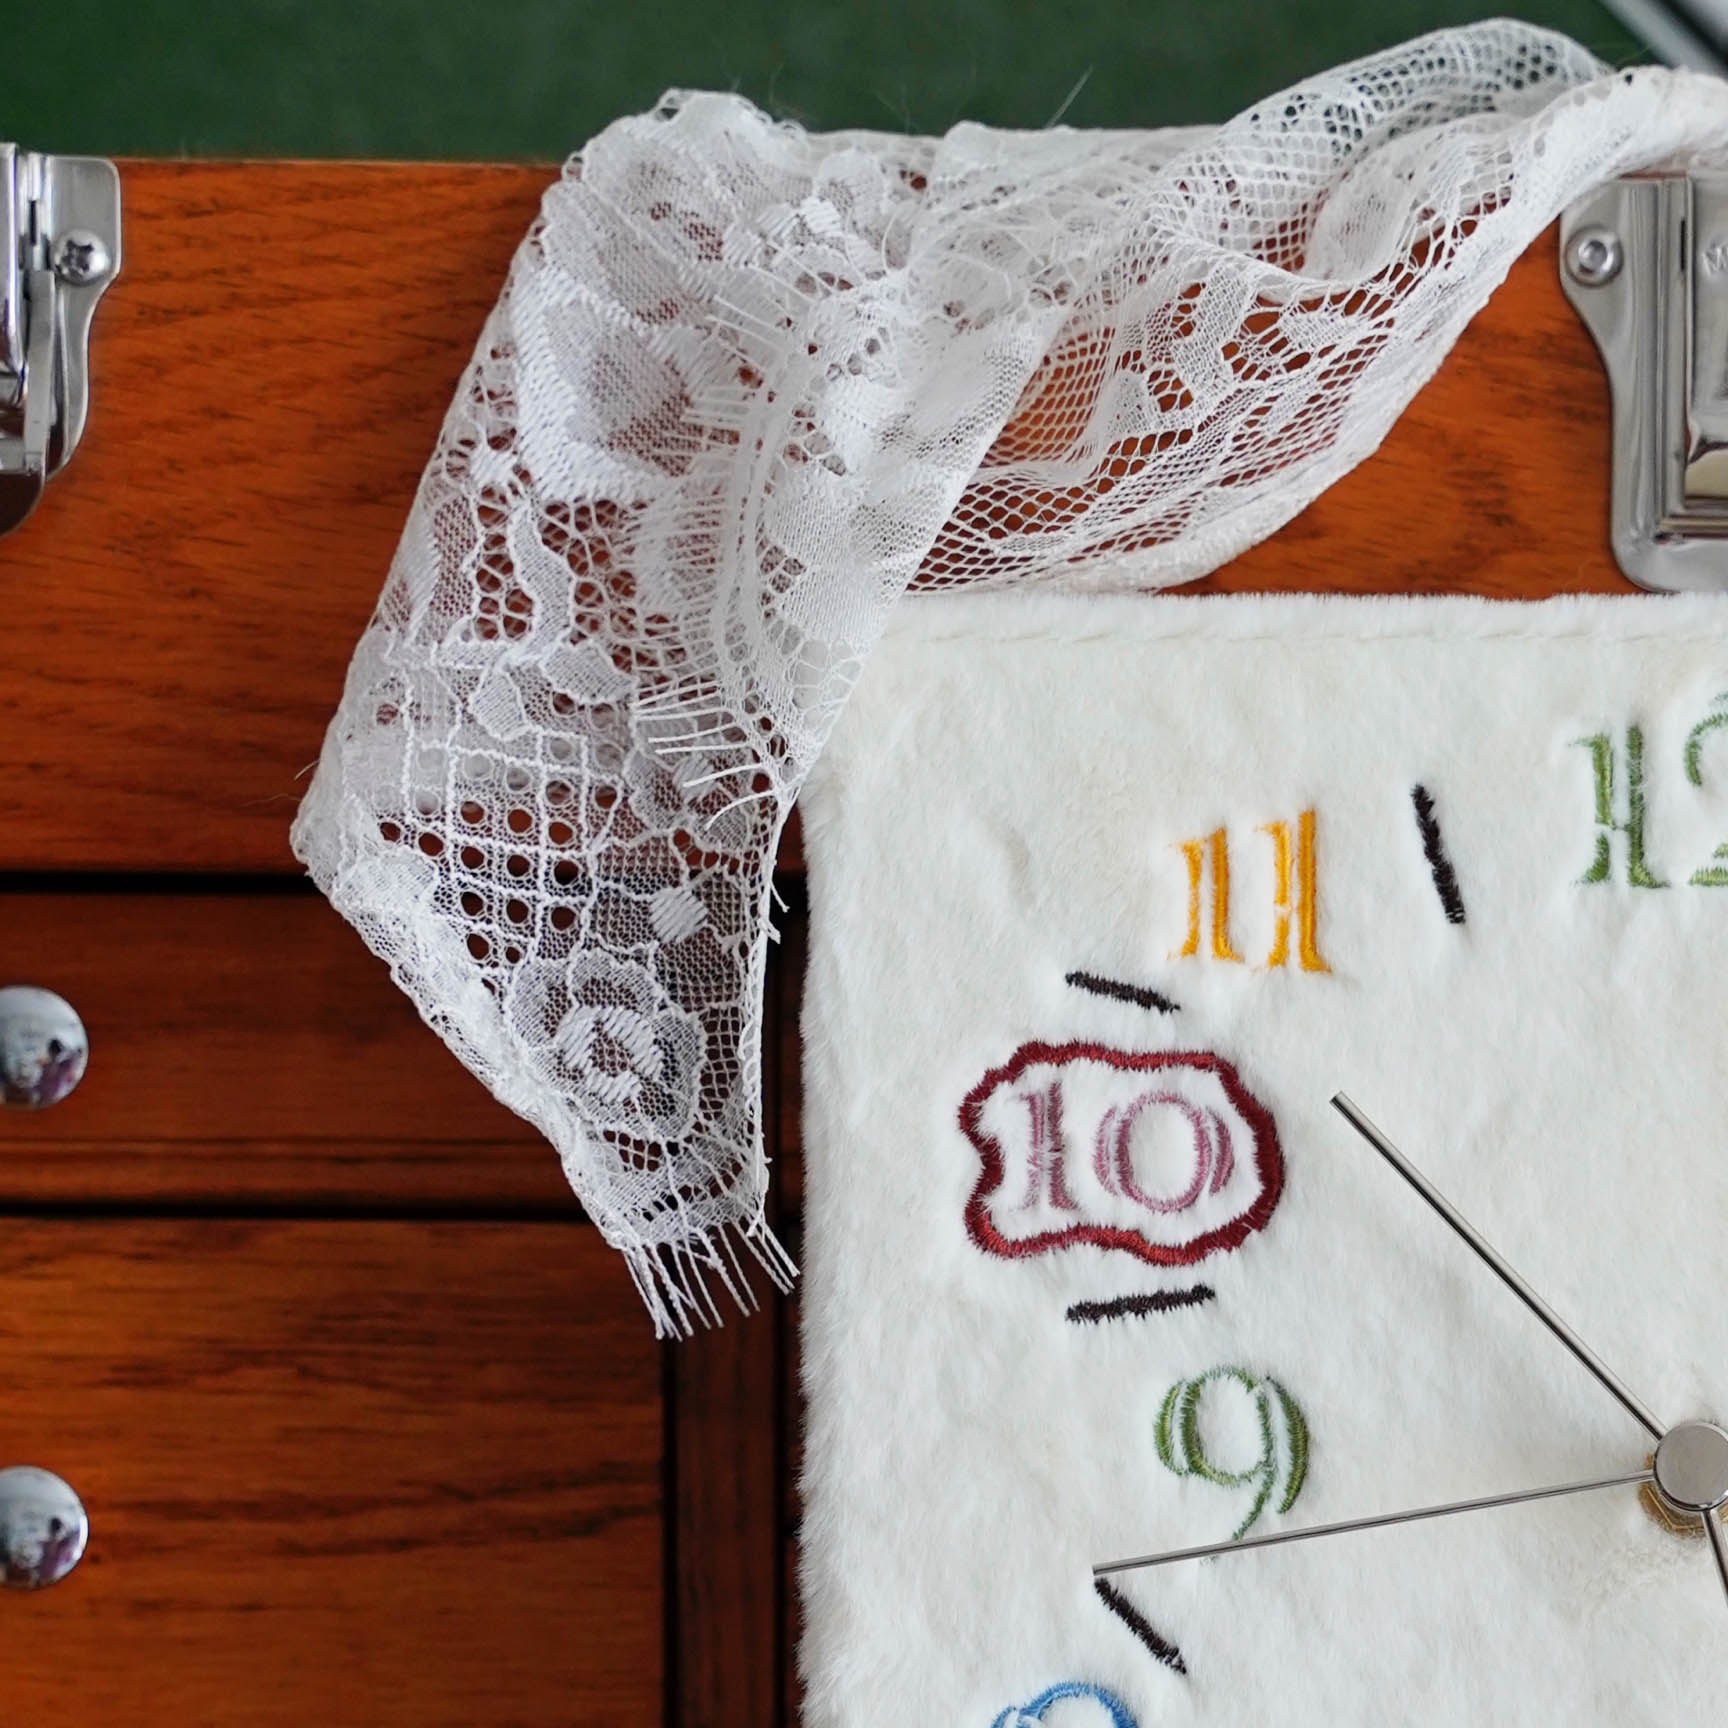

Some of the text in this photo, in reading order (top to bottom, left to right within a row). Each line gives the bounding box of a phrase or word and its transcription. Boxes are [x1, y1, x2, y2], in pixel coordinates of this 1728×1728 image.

[1168, 803, 1334, 974] 11
[1006, 1081, 1237, 1214] 10
[1154, 1366, 1309, 1562] 9
